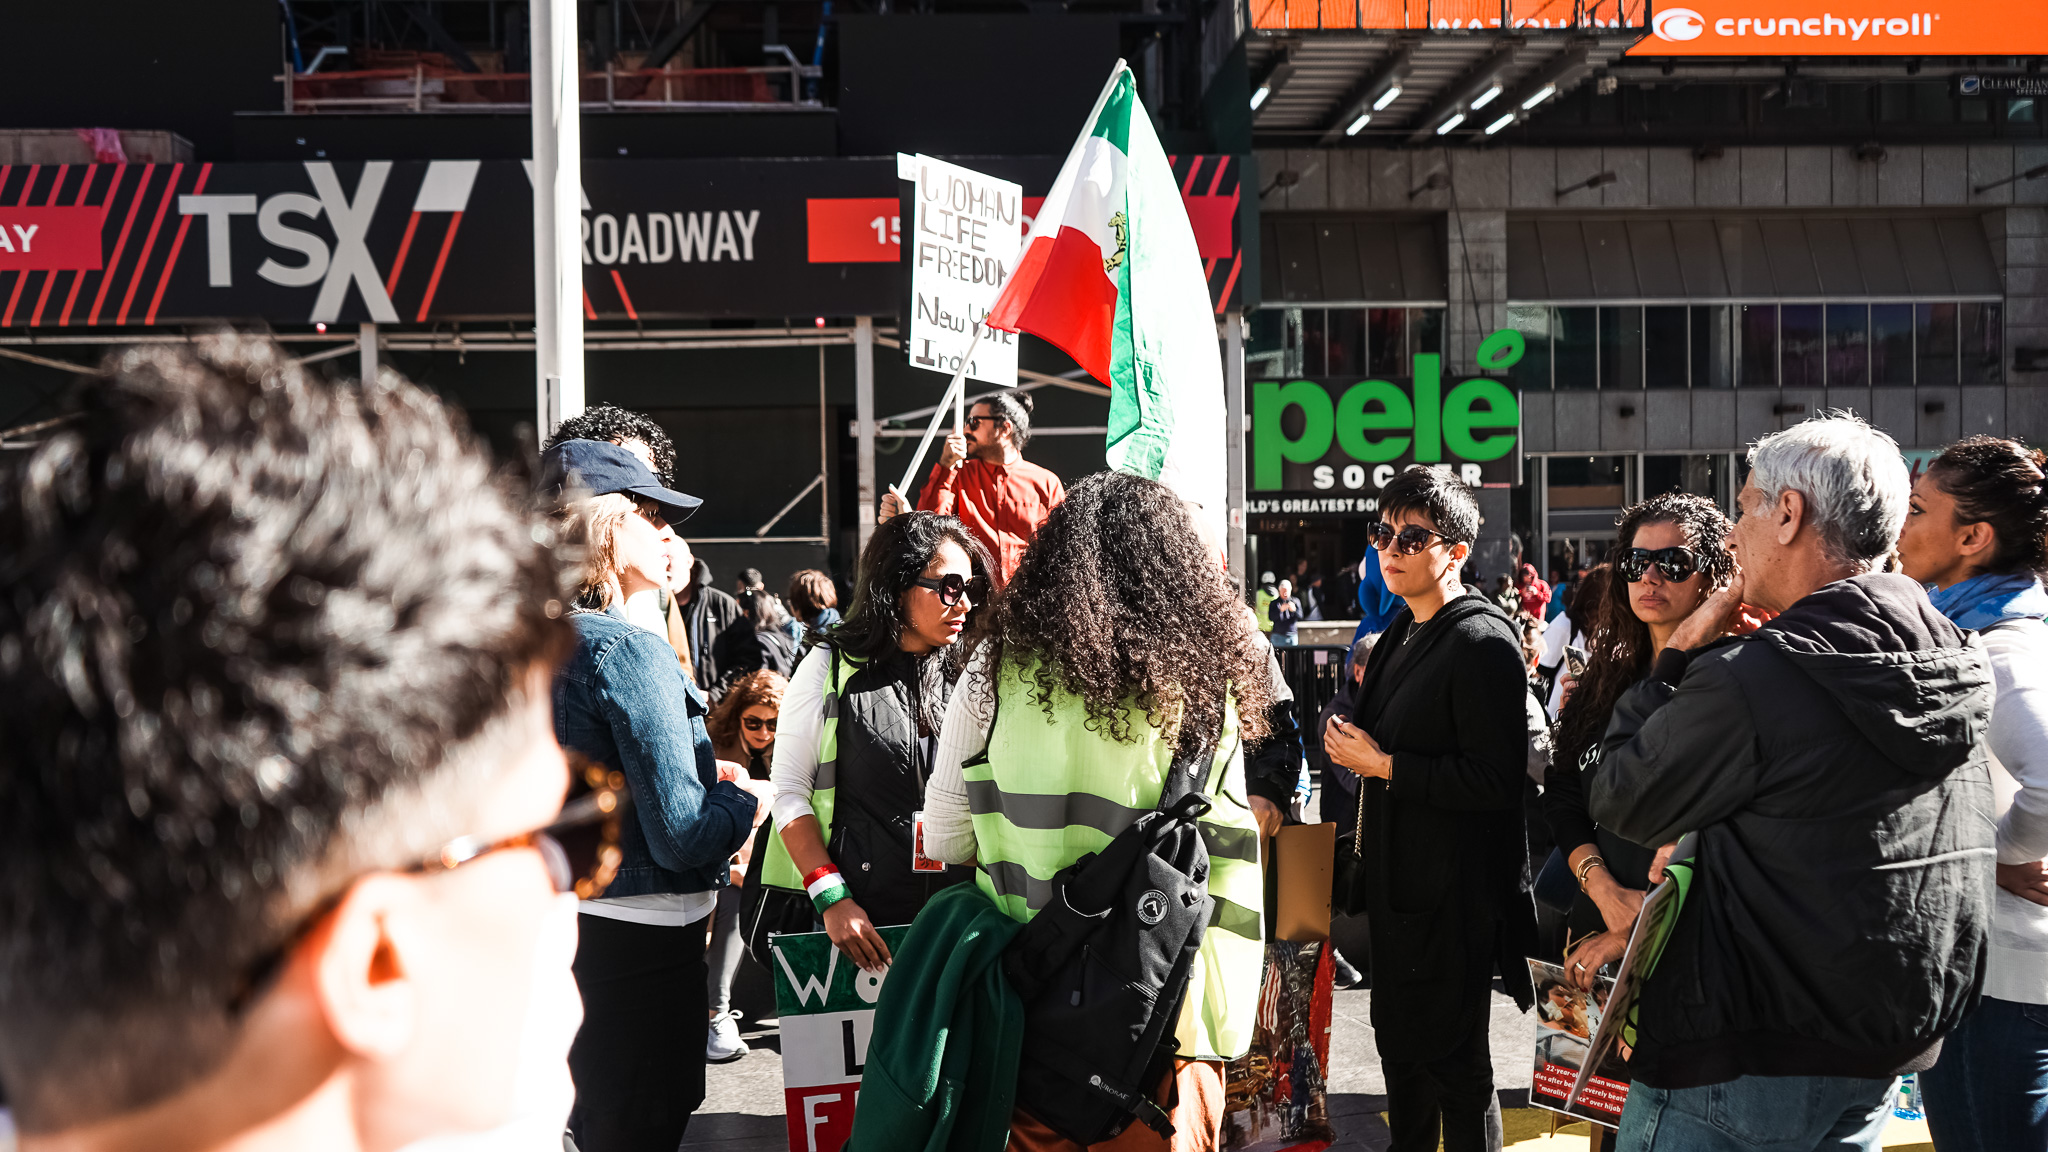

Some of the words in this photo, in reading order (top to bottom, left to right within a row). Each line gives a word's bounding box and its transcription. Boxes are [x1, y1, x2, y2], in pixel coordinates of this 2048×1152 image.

[1715, 13, 1932, 40] crunchyroll
[921, 165, 1015, 226] WOMAN
[178, 161, 400, 323] TSX
[580, 210, 760, 265] ROADWAY
[921, 202, 987, 252] LIFE
[918, 292, 965, 333] New
[1253, 328, 1525, 490] pelé
[1313, 463, 1482, 490] SOCR
[1282, 499, 1355, 513] GREATEST
[1604, 1103, 1621, 1113] hijab
[1608, 1093, 1627, 1103] beate
